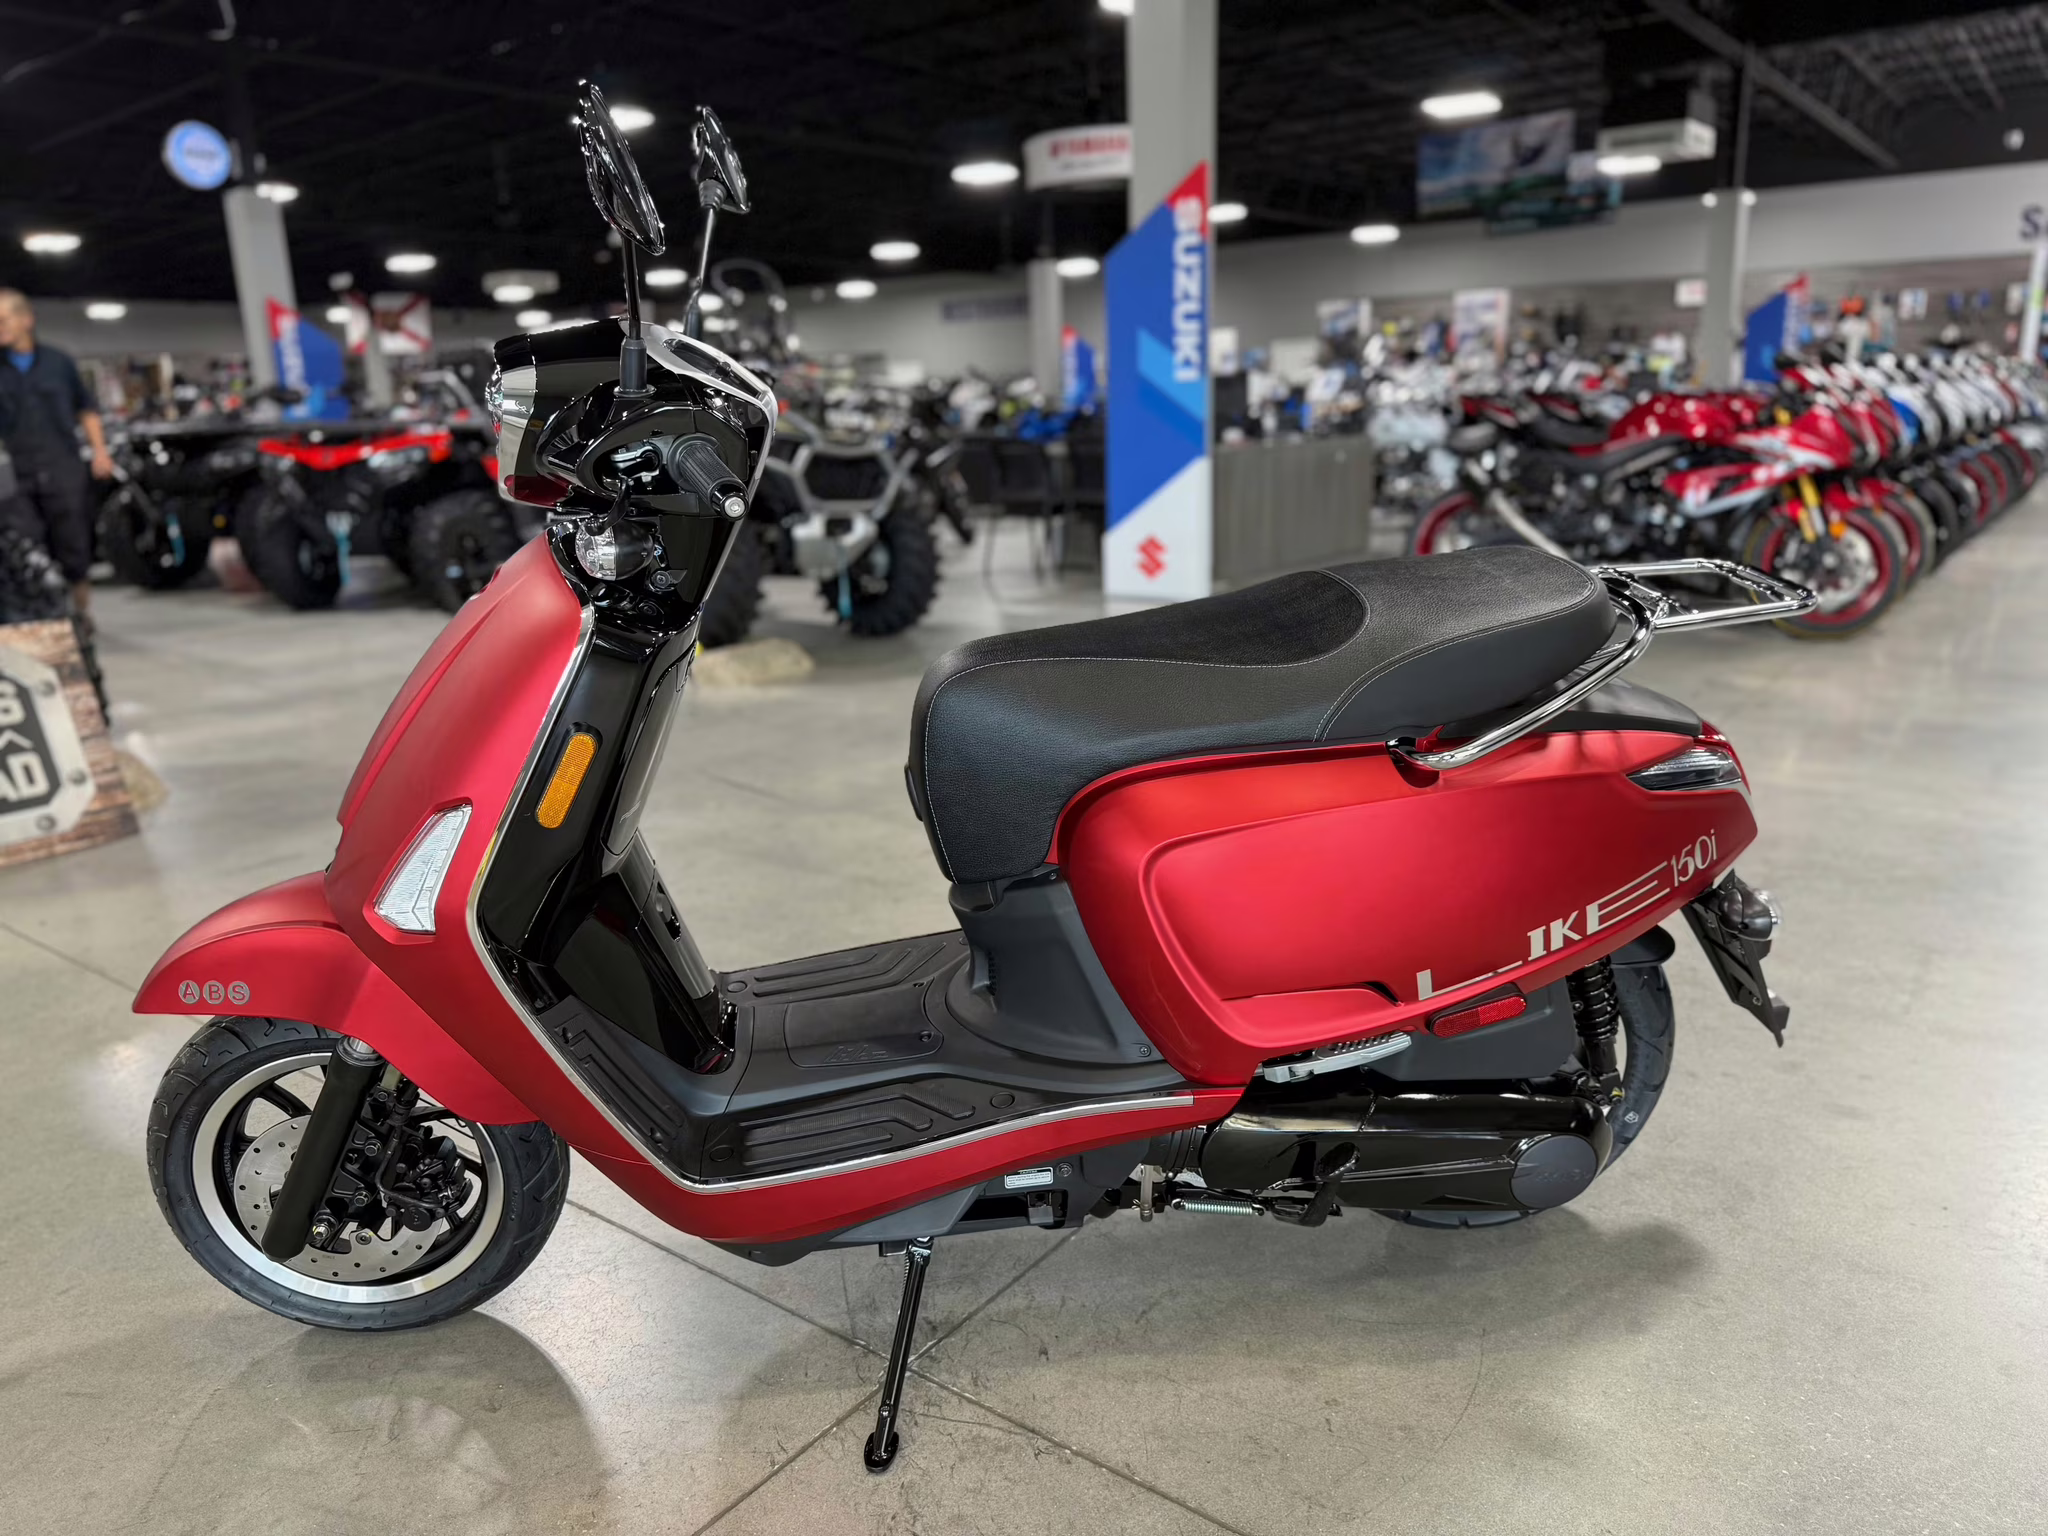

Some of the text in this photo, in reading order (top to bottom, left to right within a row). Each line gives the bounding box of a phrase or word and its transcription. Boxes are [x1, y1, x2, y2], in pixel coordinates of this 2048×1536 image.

[1173, 196, 1203, 383] SUZUKI
[178, 979, 250, 1005] ABS
[1416, 828, 1718, 1001] LIKE 150i
